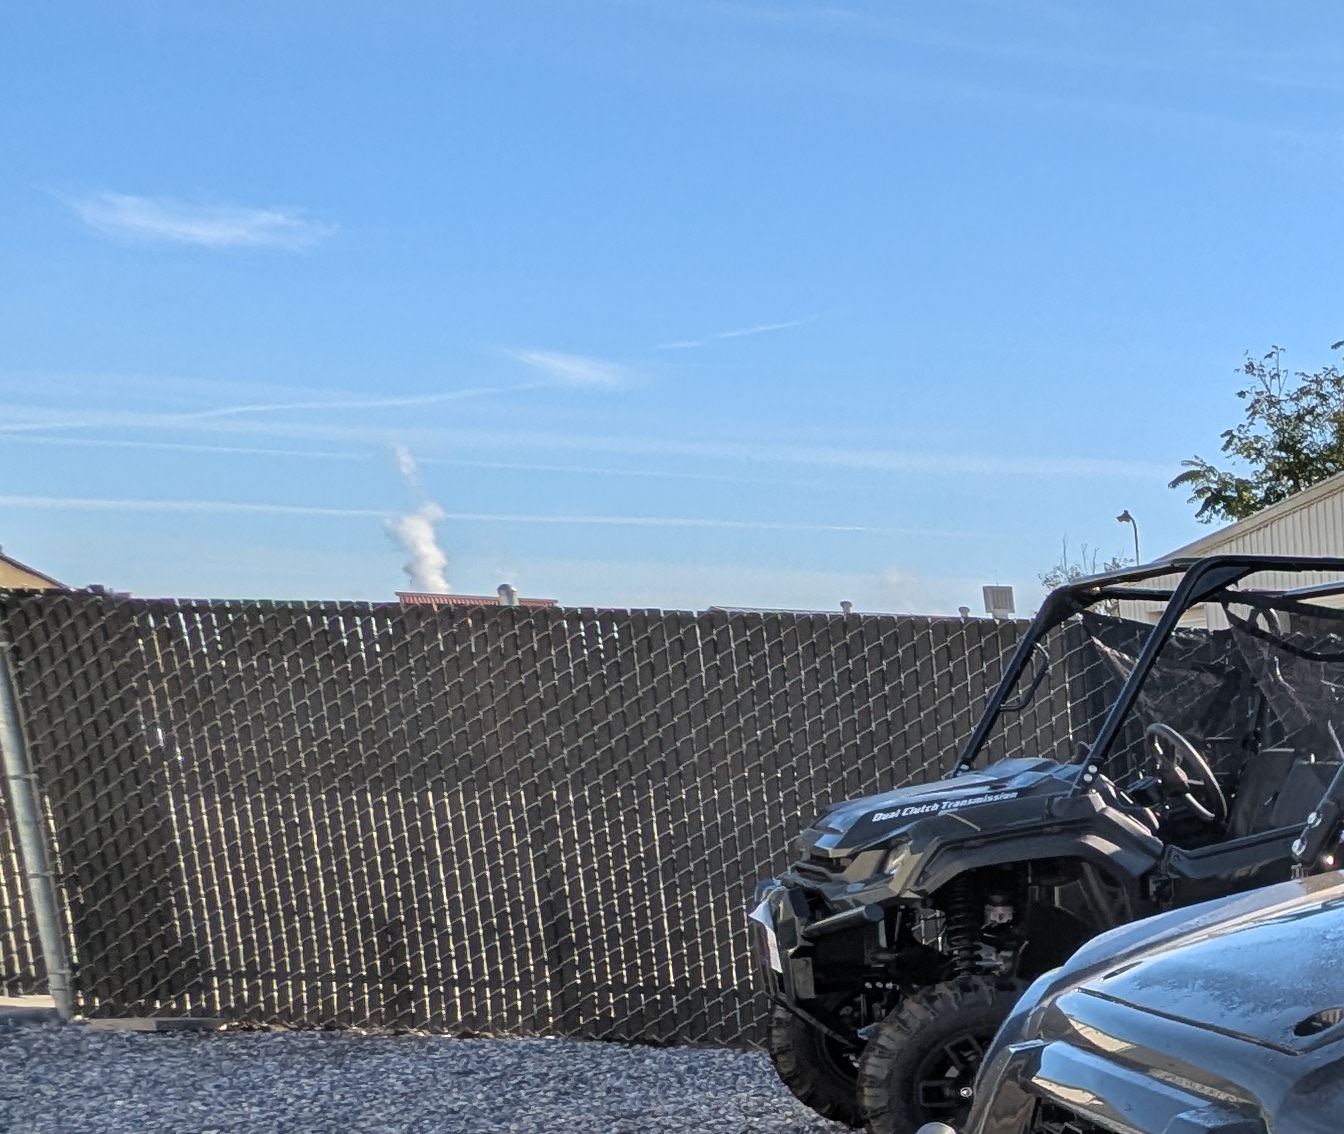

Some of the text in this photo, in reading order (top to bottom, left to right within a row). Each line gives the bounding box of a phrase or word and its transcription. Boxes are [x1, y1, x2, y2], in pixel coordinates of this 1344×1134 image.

[872, 792, 1019, 823] Dual Clutch Transmission
